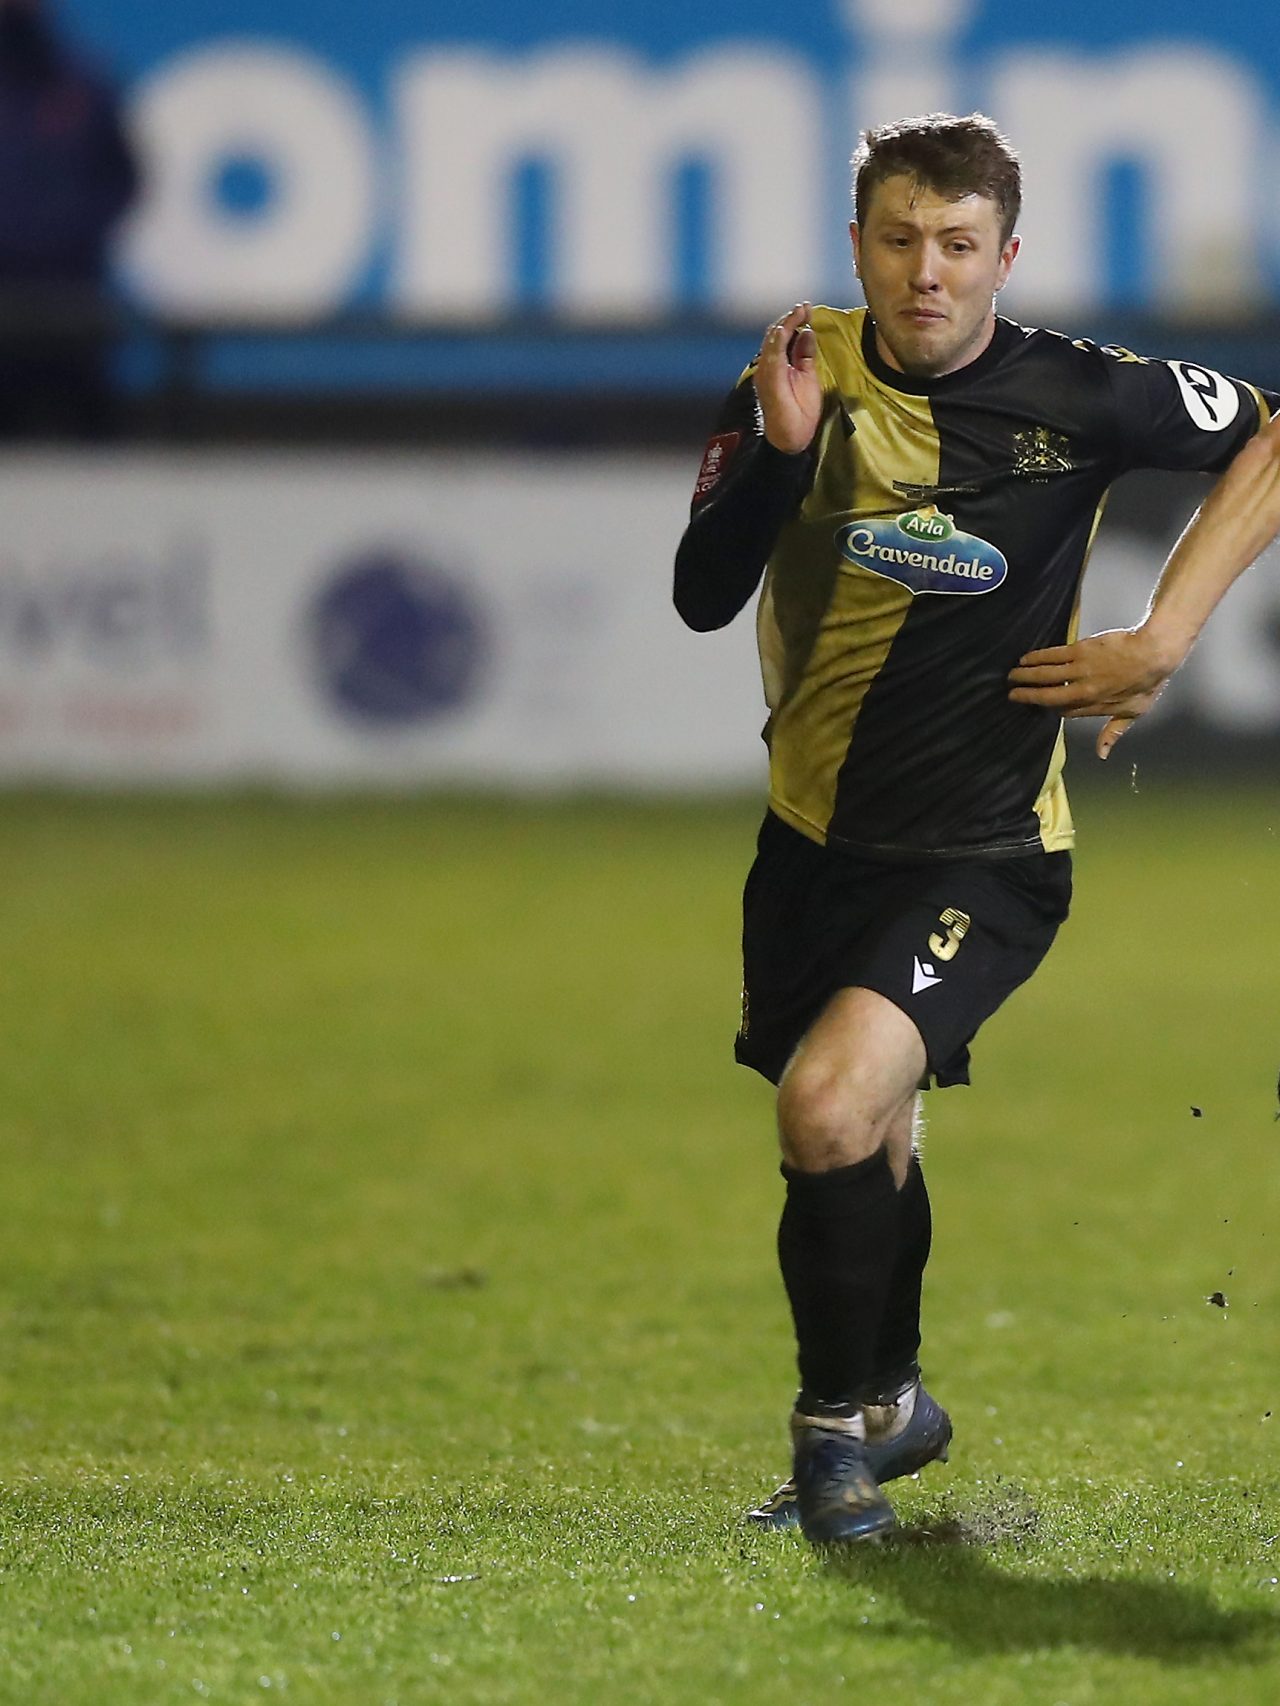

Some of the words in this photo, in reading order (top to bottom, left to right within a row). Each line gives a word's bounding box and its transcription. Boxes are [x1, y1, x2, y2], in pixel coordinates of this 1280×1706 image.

[906, 516, 945, 537] Arla
[846, 528, 995, 582] Cravendale
[927, 907, 971, 962] 3
